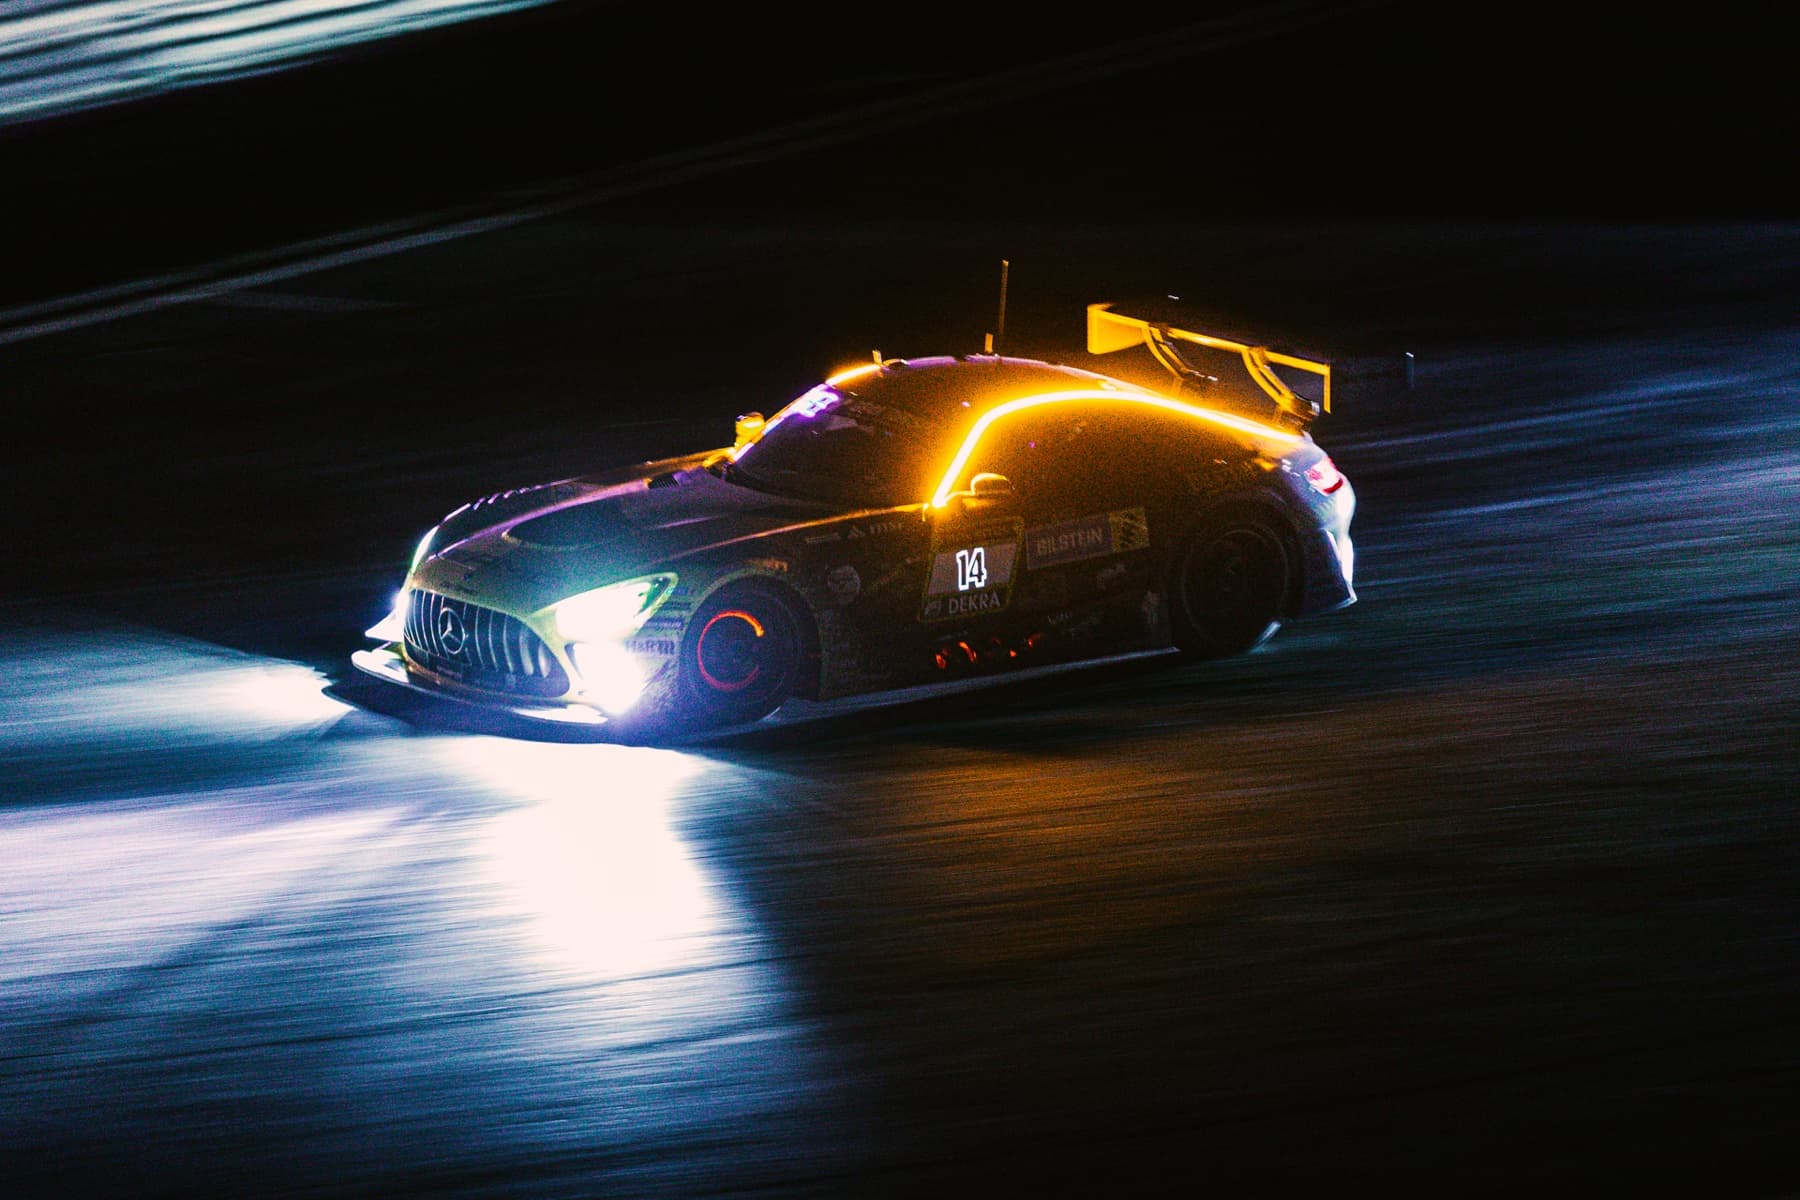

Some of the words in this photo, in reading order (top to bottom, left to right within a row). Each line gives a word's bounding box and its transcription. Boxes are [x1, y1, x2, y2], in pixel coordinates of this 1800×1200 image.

[1037, 526, 1103, 556] BILSTEIN
[956, 547, 987, 591] 14
[948, 591, 1001, 613] DEKRA
